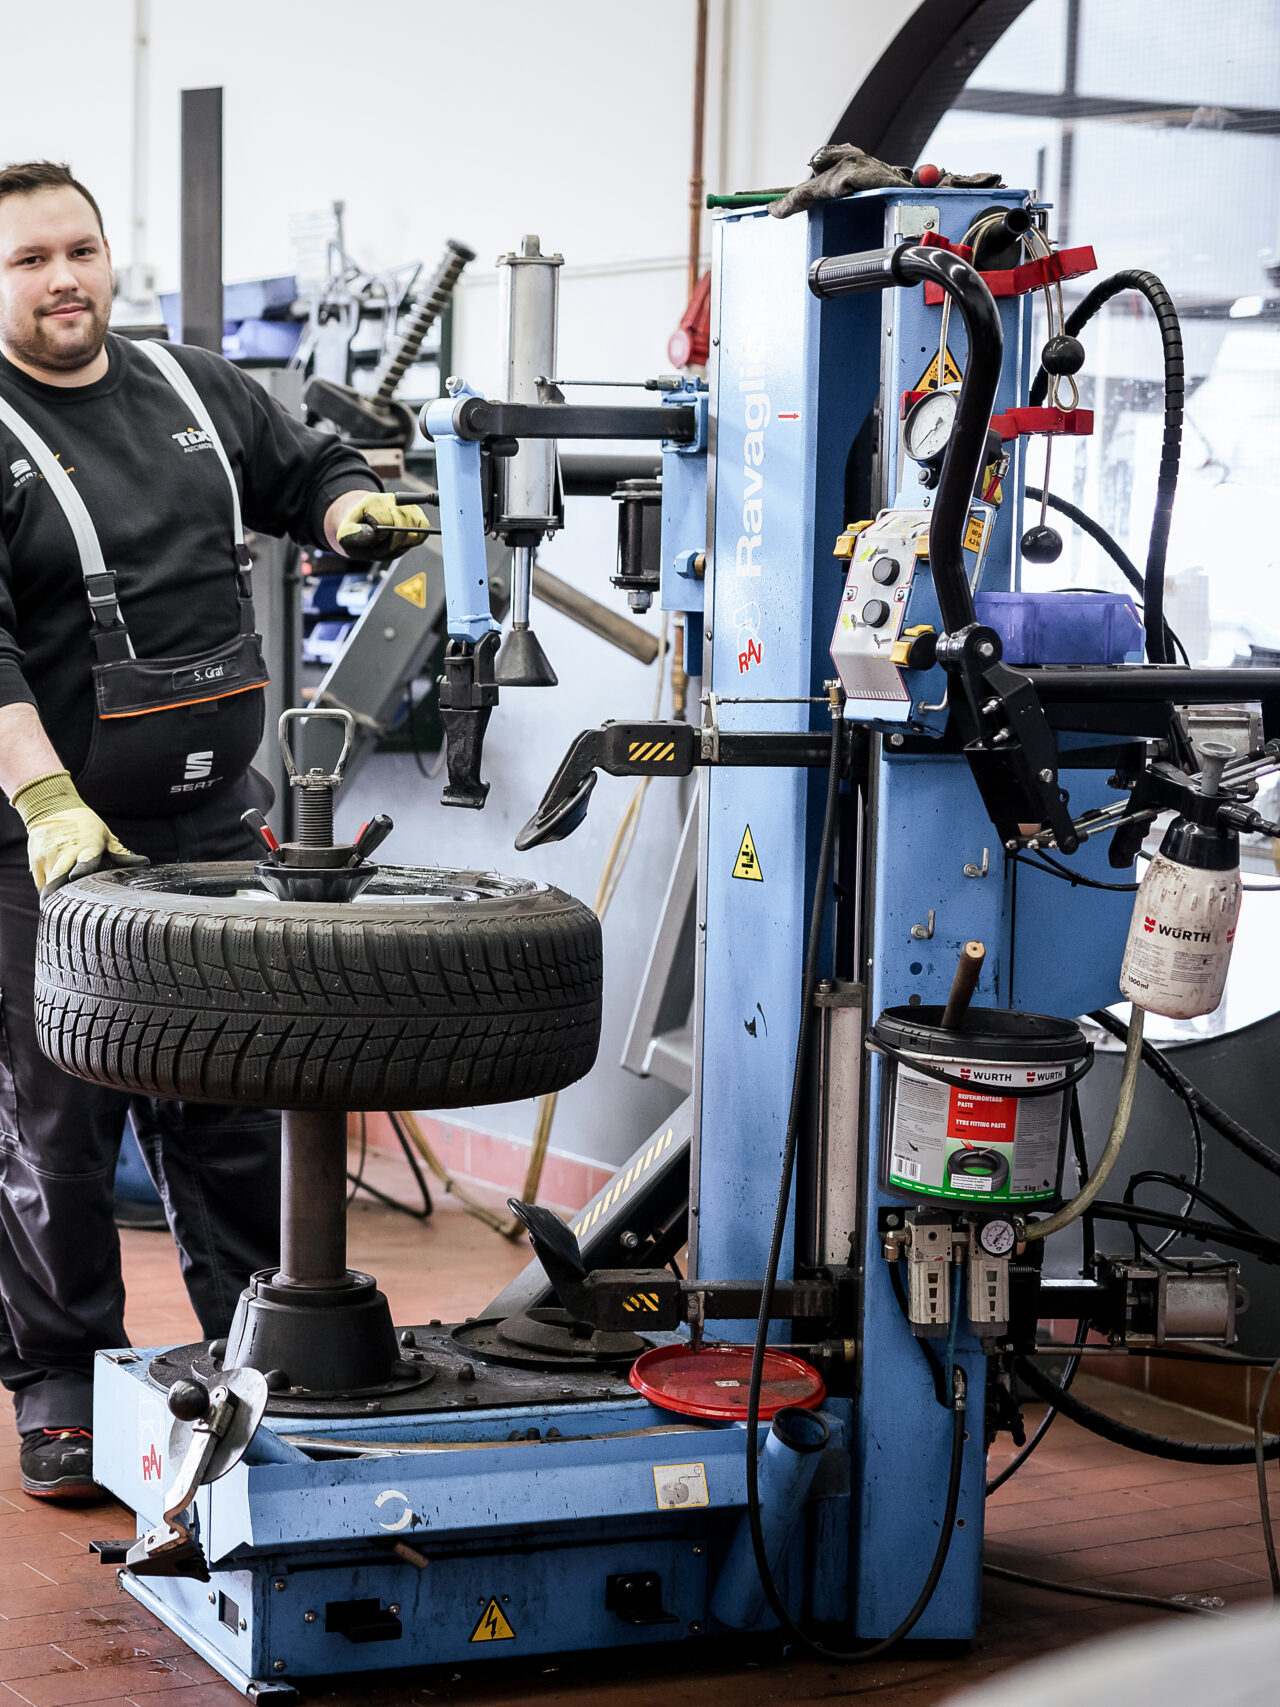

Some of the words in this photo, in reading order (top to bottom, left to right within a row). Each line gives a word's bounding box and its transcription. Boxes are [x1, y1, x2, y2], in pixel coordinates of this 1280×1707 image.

[738, 638, 762, 674] RAV
[193, 669, 204, 681] S.
[205, 664, 224, 679] Graf
[169, 776, 224, 793] SEAT
[1159, 924, 1211, 943] WÜRTH
[973, 1071, 1012, 1082] WÜRTH
[1037, 1071, 1063, 1081] WÜRTH
[957, 1101, 974, 1109] PASTE
[955, 1118, 970, 1126] TYRE
[970, 1120, 990, 1128] FITTING
[142, 1443, 162, 1481] RAV
